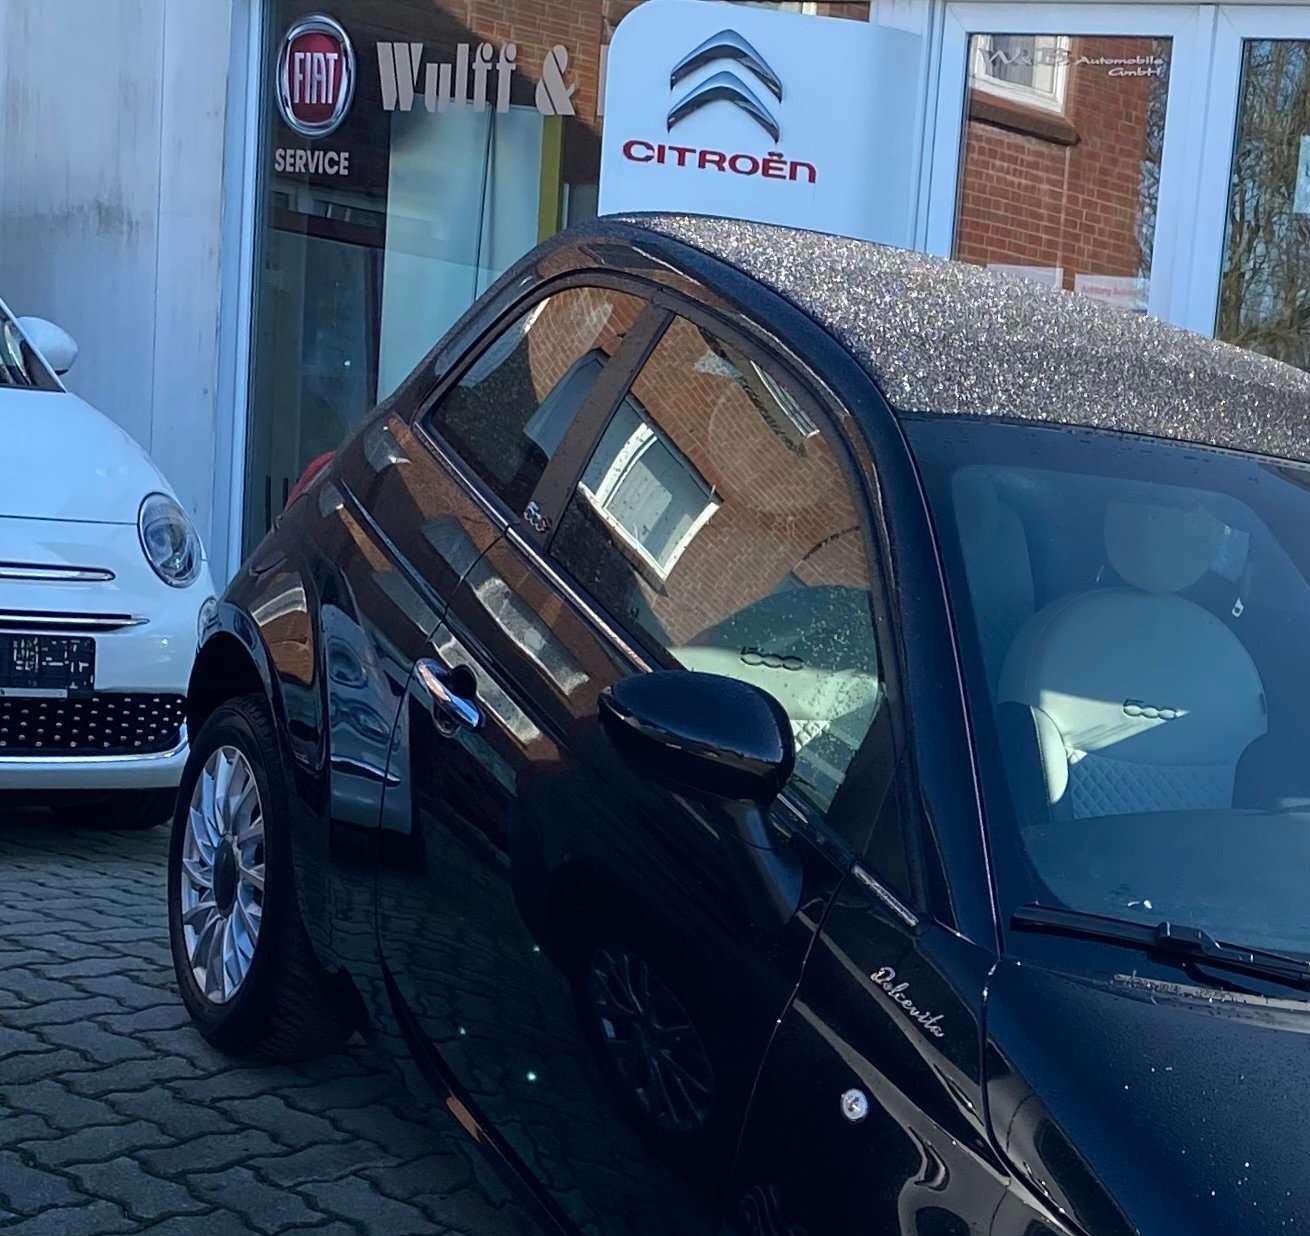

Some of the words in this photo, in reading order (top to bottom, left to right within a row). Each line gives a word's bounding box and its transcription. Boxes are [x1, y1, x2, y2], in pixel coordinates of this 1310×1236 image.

[293, 52, 338, 104] FIAT
[376, 42, 517, 113] Wulff
[535, 44, 576, 116] &
[274, 148, 349, 176] SERVICE
